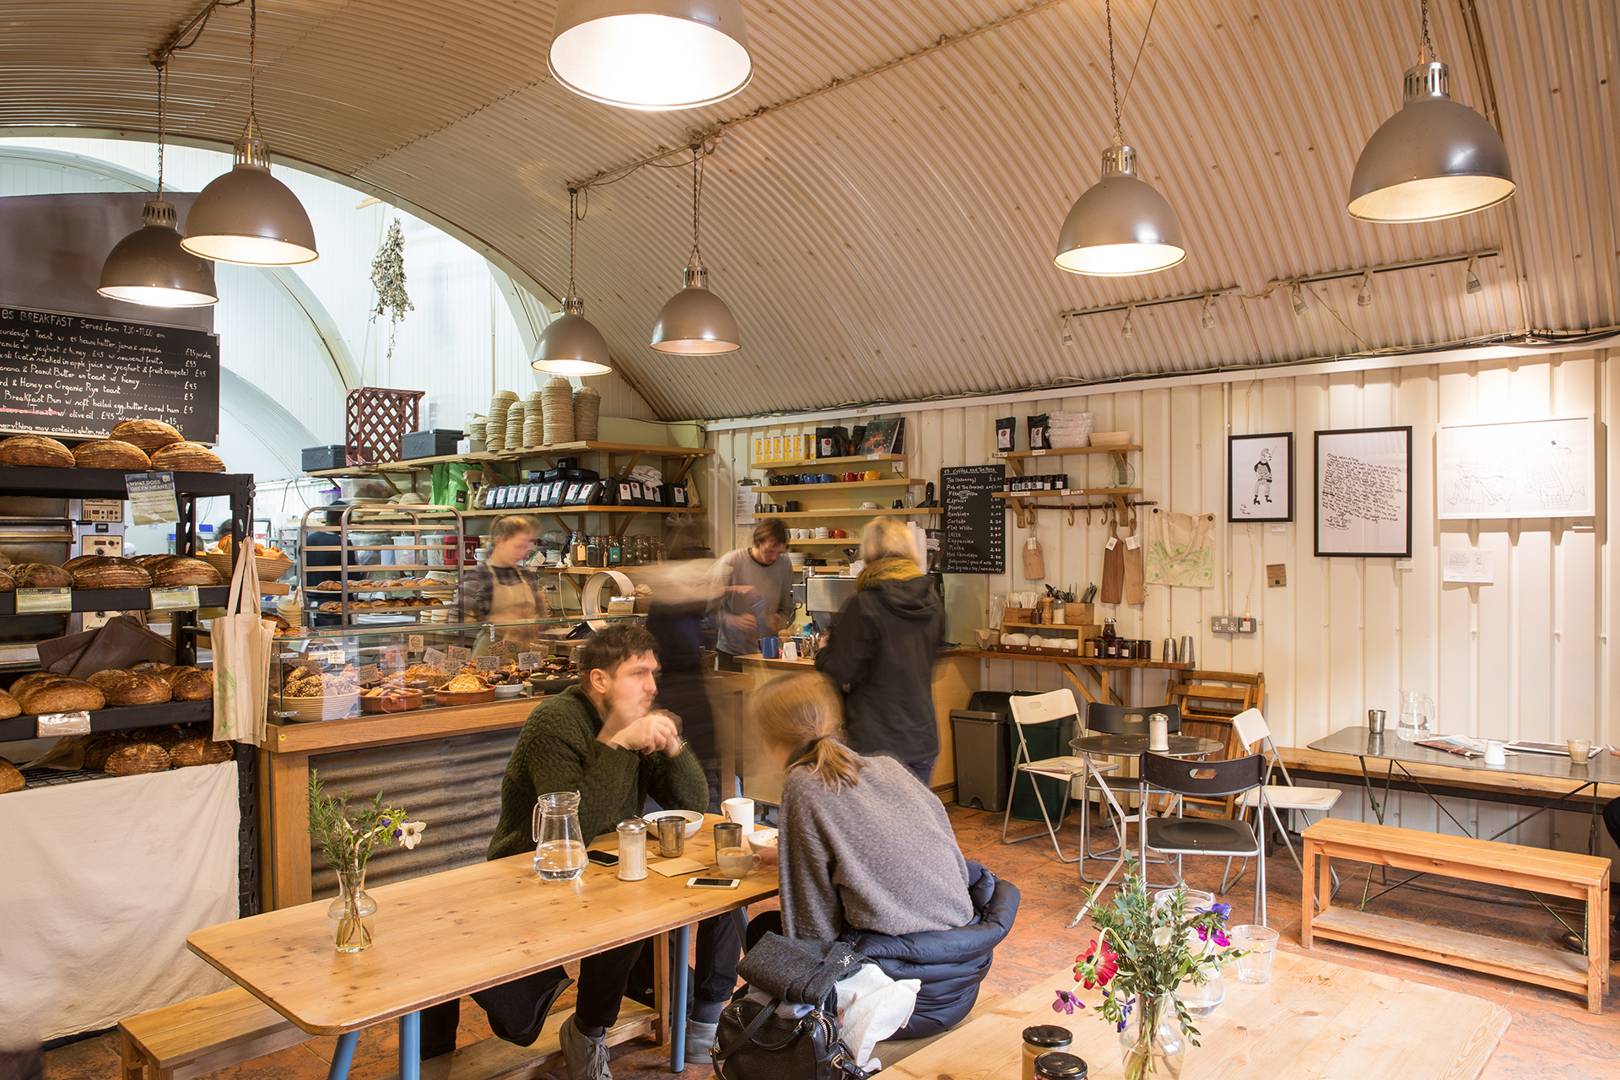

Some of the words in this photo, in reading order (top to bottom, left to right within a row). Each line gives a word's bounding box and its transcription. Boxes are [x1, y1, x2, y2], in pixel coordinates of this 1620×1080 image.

[20, 311, 74, 327] BREAKFAST
[80, 319, 103, 331] Served
[105, 322, 119, 332] from
[30, 363, 52, 375] Peanut
[54, 366, 75, 378] Butter
[87, 372, 106, 380] toast
[86, 360, 103, 372] juice
[20, 377, 42, 394] Honey
[55, 380, 84, 395] Organic
[85, 381, 99, 398] Rye
[103, 384, 121, 394] toast
[5, 390, 45, 407] Breakfast
